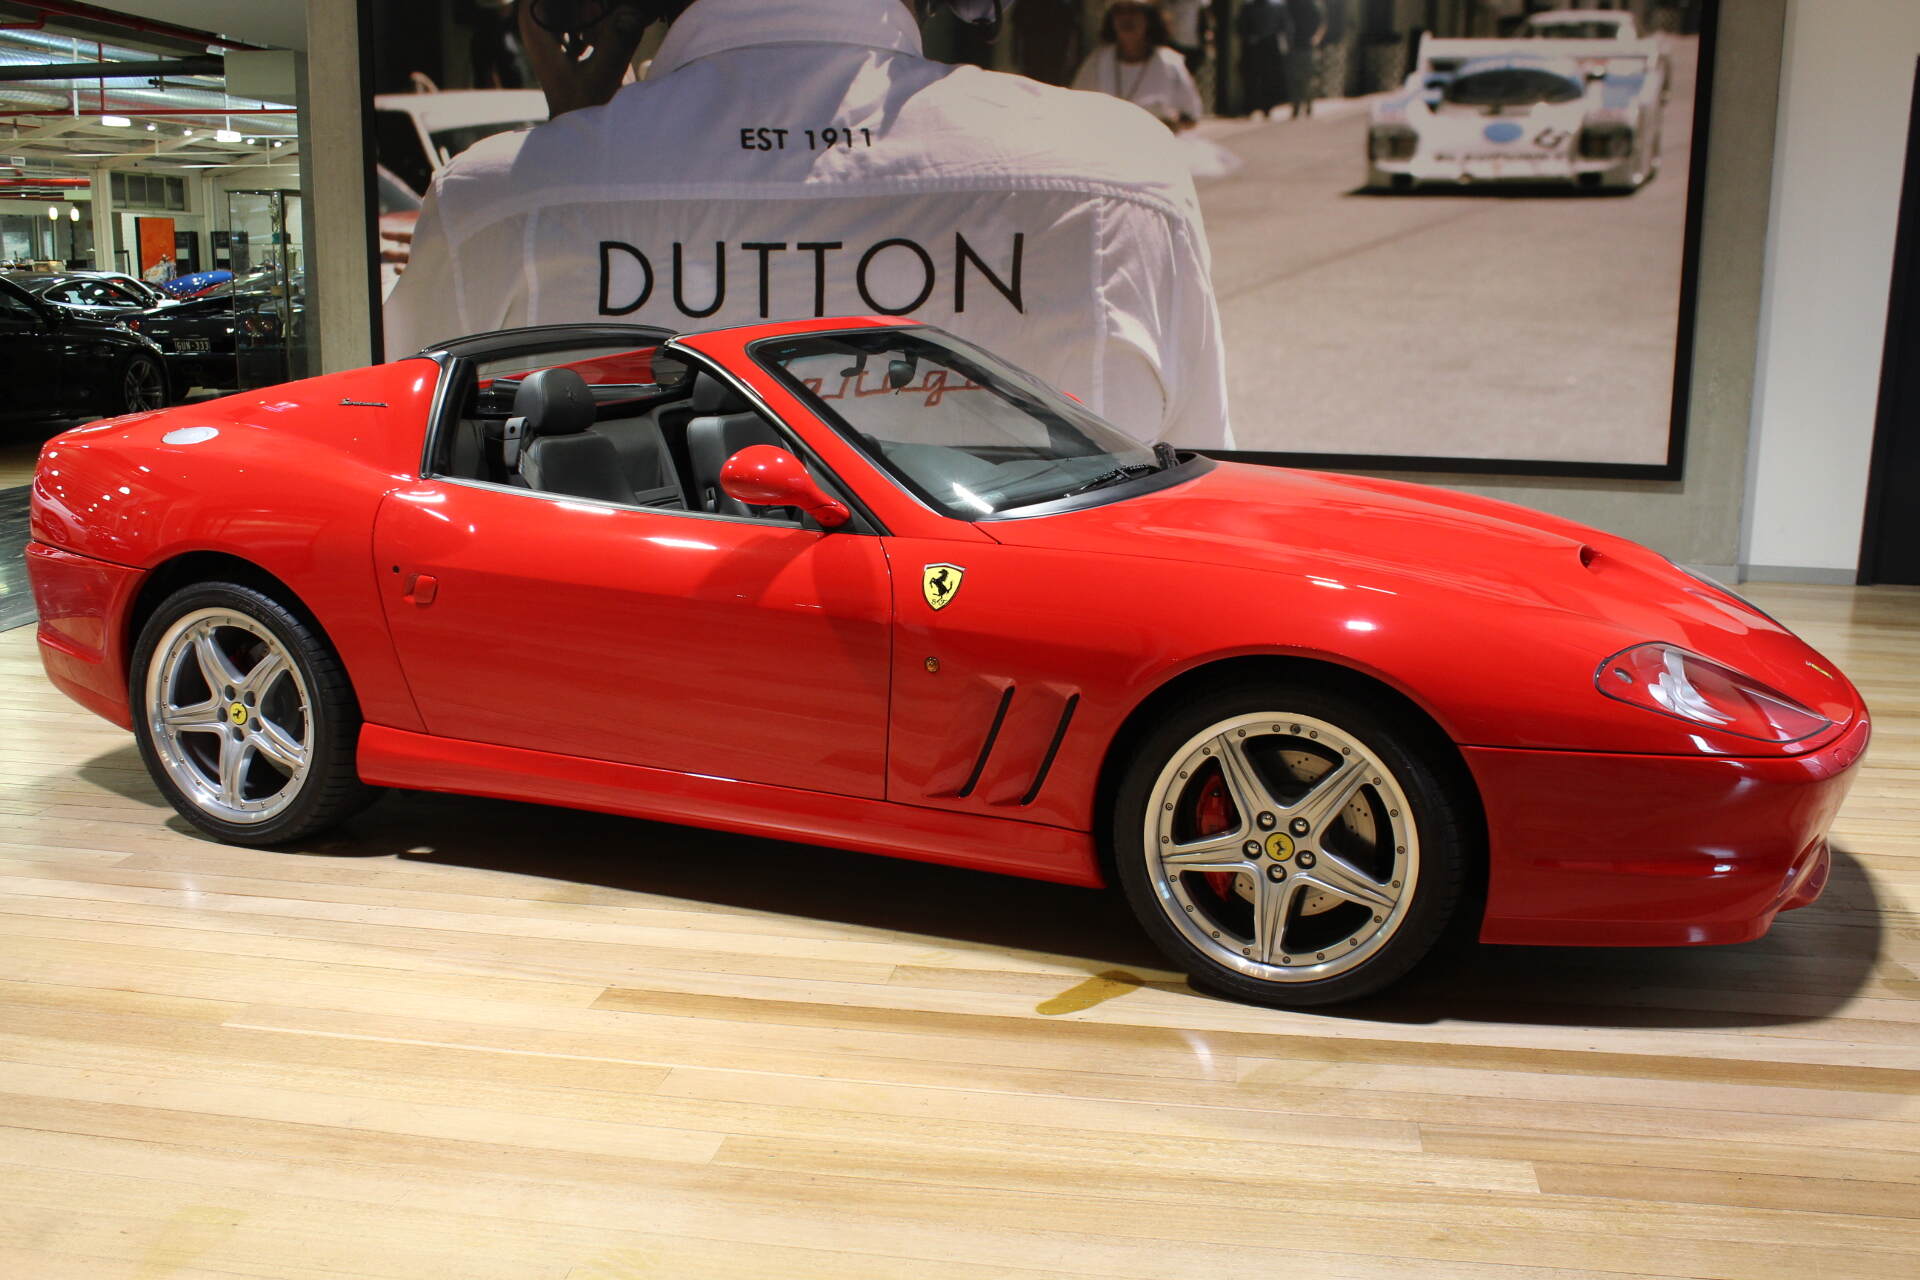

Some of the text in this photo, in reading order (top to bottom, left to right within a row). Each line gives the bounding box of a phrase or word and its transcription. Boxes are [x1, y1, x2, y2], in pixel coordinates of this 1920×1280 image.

[740, 127, 872, 151] EST 1911
[599, 231, 1025, 318] DUTTON
